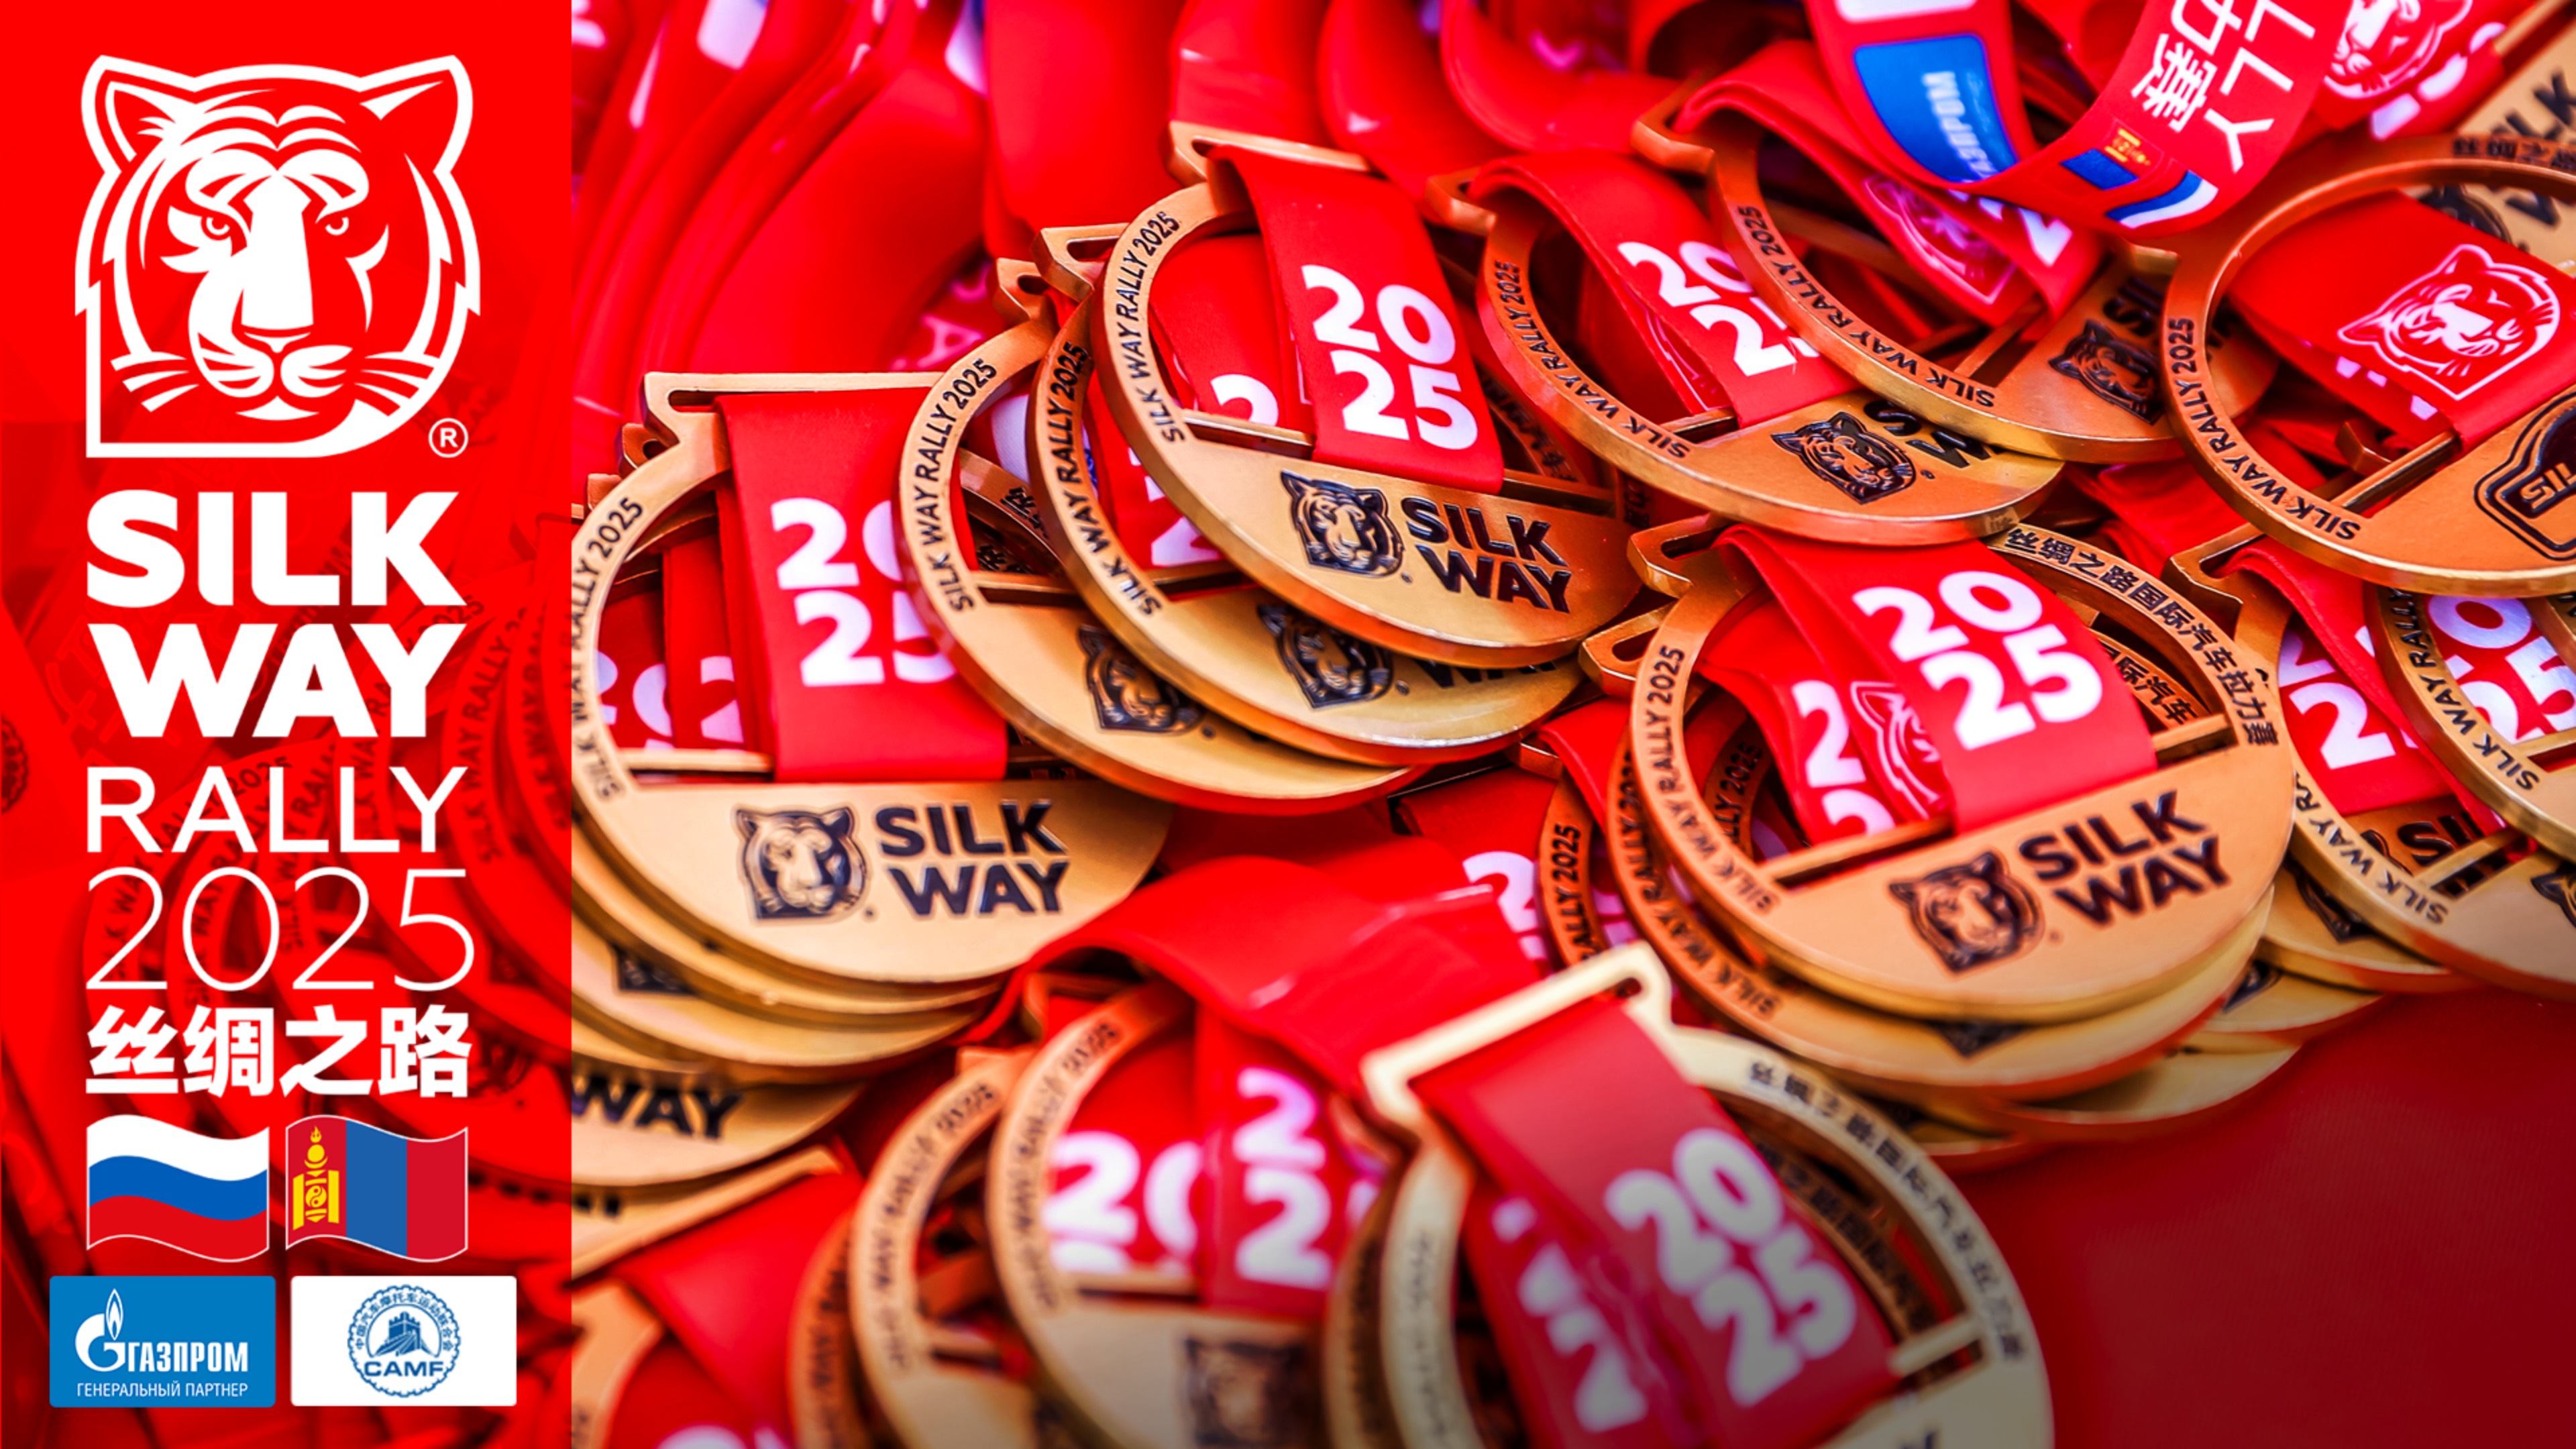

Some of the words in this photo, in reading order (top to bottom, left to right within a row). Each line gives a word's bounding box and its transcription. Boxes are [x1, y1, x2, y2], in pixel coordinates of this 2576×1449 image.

[1131, 211, 1181, 257] 2025
[1736, 205, 1785, 256] 2025
[1115, 250, 1148, 321] RALLY
[1495, 260, 1526, 306] 2025
[1772, 260, 1853, 328] RALLY
[1301, 264, 1456, 364] 20
[1505, 307, 1568, 370] RALLY
[1051, 341, 1090, 395] 2025
[1116, 321, 1150, 379] WAY
[1849, 330, 1918, 376] WAY
[2167, 318, 2196, 374] 2025
[943, 358, 998, 410] 2025
[1330, 350, 1478, 450] 25
[1555, 374, 1619, 419] WAY
[1926, 367, 1996, 408] SILK
[915, 403, 957, 482] RALLY
[1048, 398, 1083, 484] RALLY
[1136, 387, 1186, 443] SILK
[1619, 415, 1690, 459] SILK
[2176, 379, 2237, 453] RALLY
[2223, 455, 2288, 505] WAY
[588, 497, 643, 559] 2025
[913, 485, 943, 546] WAY
[1063, 490, 1111, 553] WAY
[1400, 496, 1569, 568] SILK
[2287, 496, 2361, 540] SILK
[925, 552, 975, 612] SILK
[1102, 555, 1163, 615] SILK
[1415, 543, 1572, 614] WAY
[1852, 570, 2043, 663] 20
[1648, 645, 1686, 704] 2025
[1919, 623, 2103, 751] 25
[2419, 674, 2477, 735] WAY
[1645, 710, 1686, 795] RALLY
[2473, 733, 2540, 790] SILK
[875, 799, 1069, 857] SILK
[1550, 822, 1582, 884] 2025
[2018, 790, 2208, 881] SILK
[2308, 816, 2375, 877] WAY
[886, 861, 1069, 915] WAY
[2053, 834, 2232, 925] WAY
[2377, 867, 2450, 926] SILK
[1605, 1127, 1784, 1295] 20
[1693, 1224, 1856, 1407] 25
